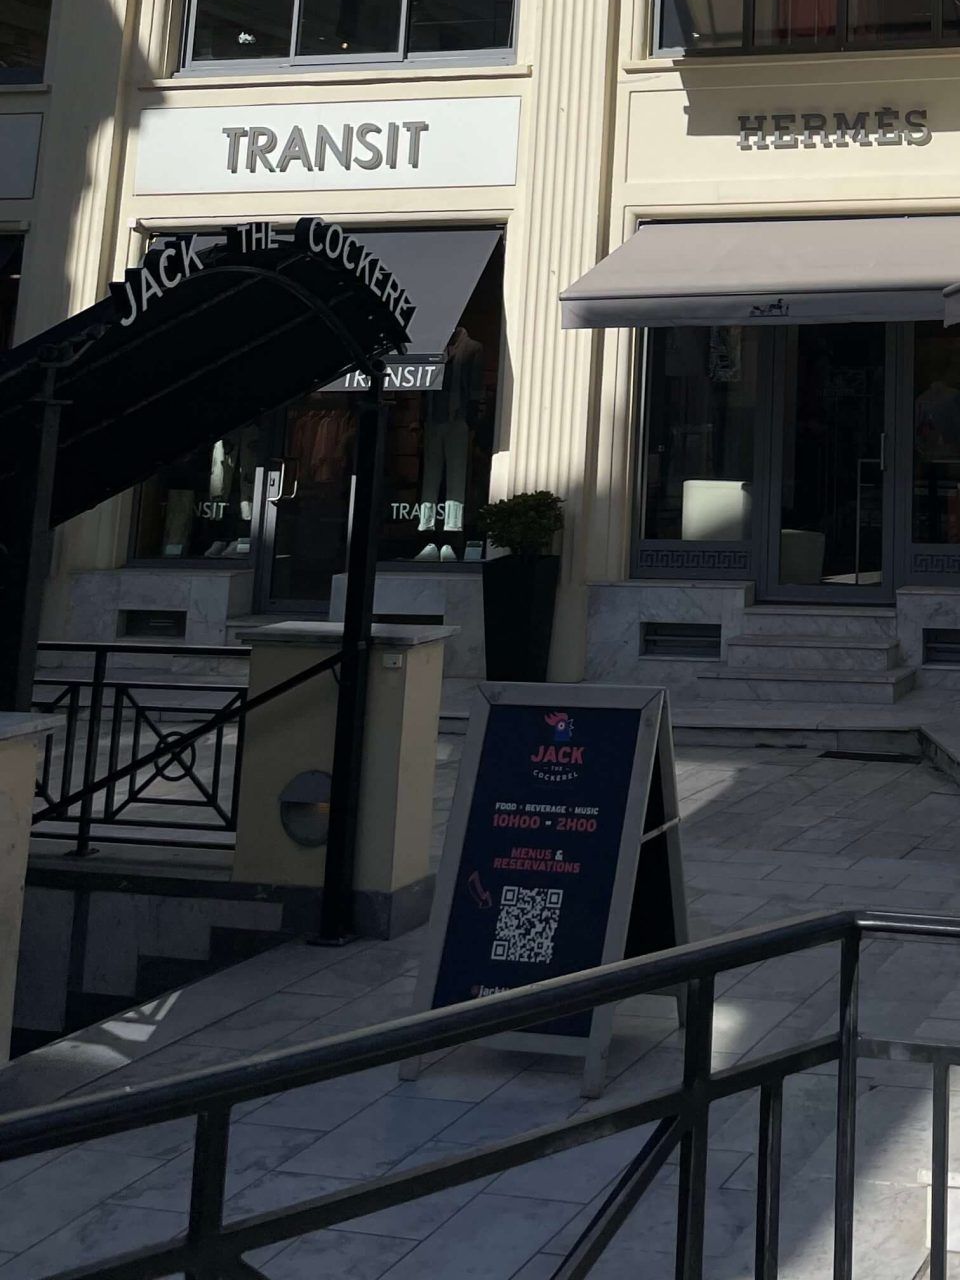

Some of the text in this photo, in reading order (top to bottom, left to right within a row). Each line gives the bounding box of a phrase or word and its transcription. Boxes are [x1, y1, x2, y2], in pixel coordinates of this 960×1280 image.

[737, 107, 933, 151] HERMÈS
[222, 121, 429, 174] TRANSIT
[119, 234, 204, 327] JACK
[237, 224, 279, 253] THE
[344, 366, 436, 389] RNSIT
[530, 745, 585, 764] JACK
[532, 769, 579, 782] COCKEREL
[495, 802, 599, 815] FOOD BEVERAGE MUSIC
[511, 847, 563, 861] MENUS &
[493, 858, 581, 873] RESERVATIONS
